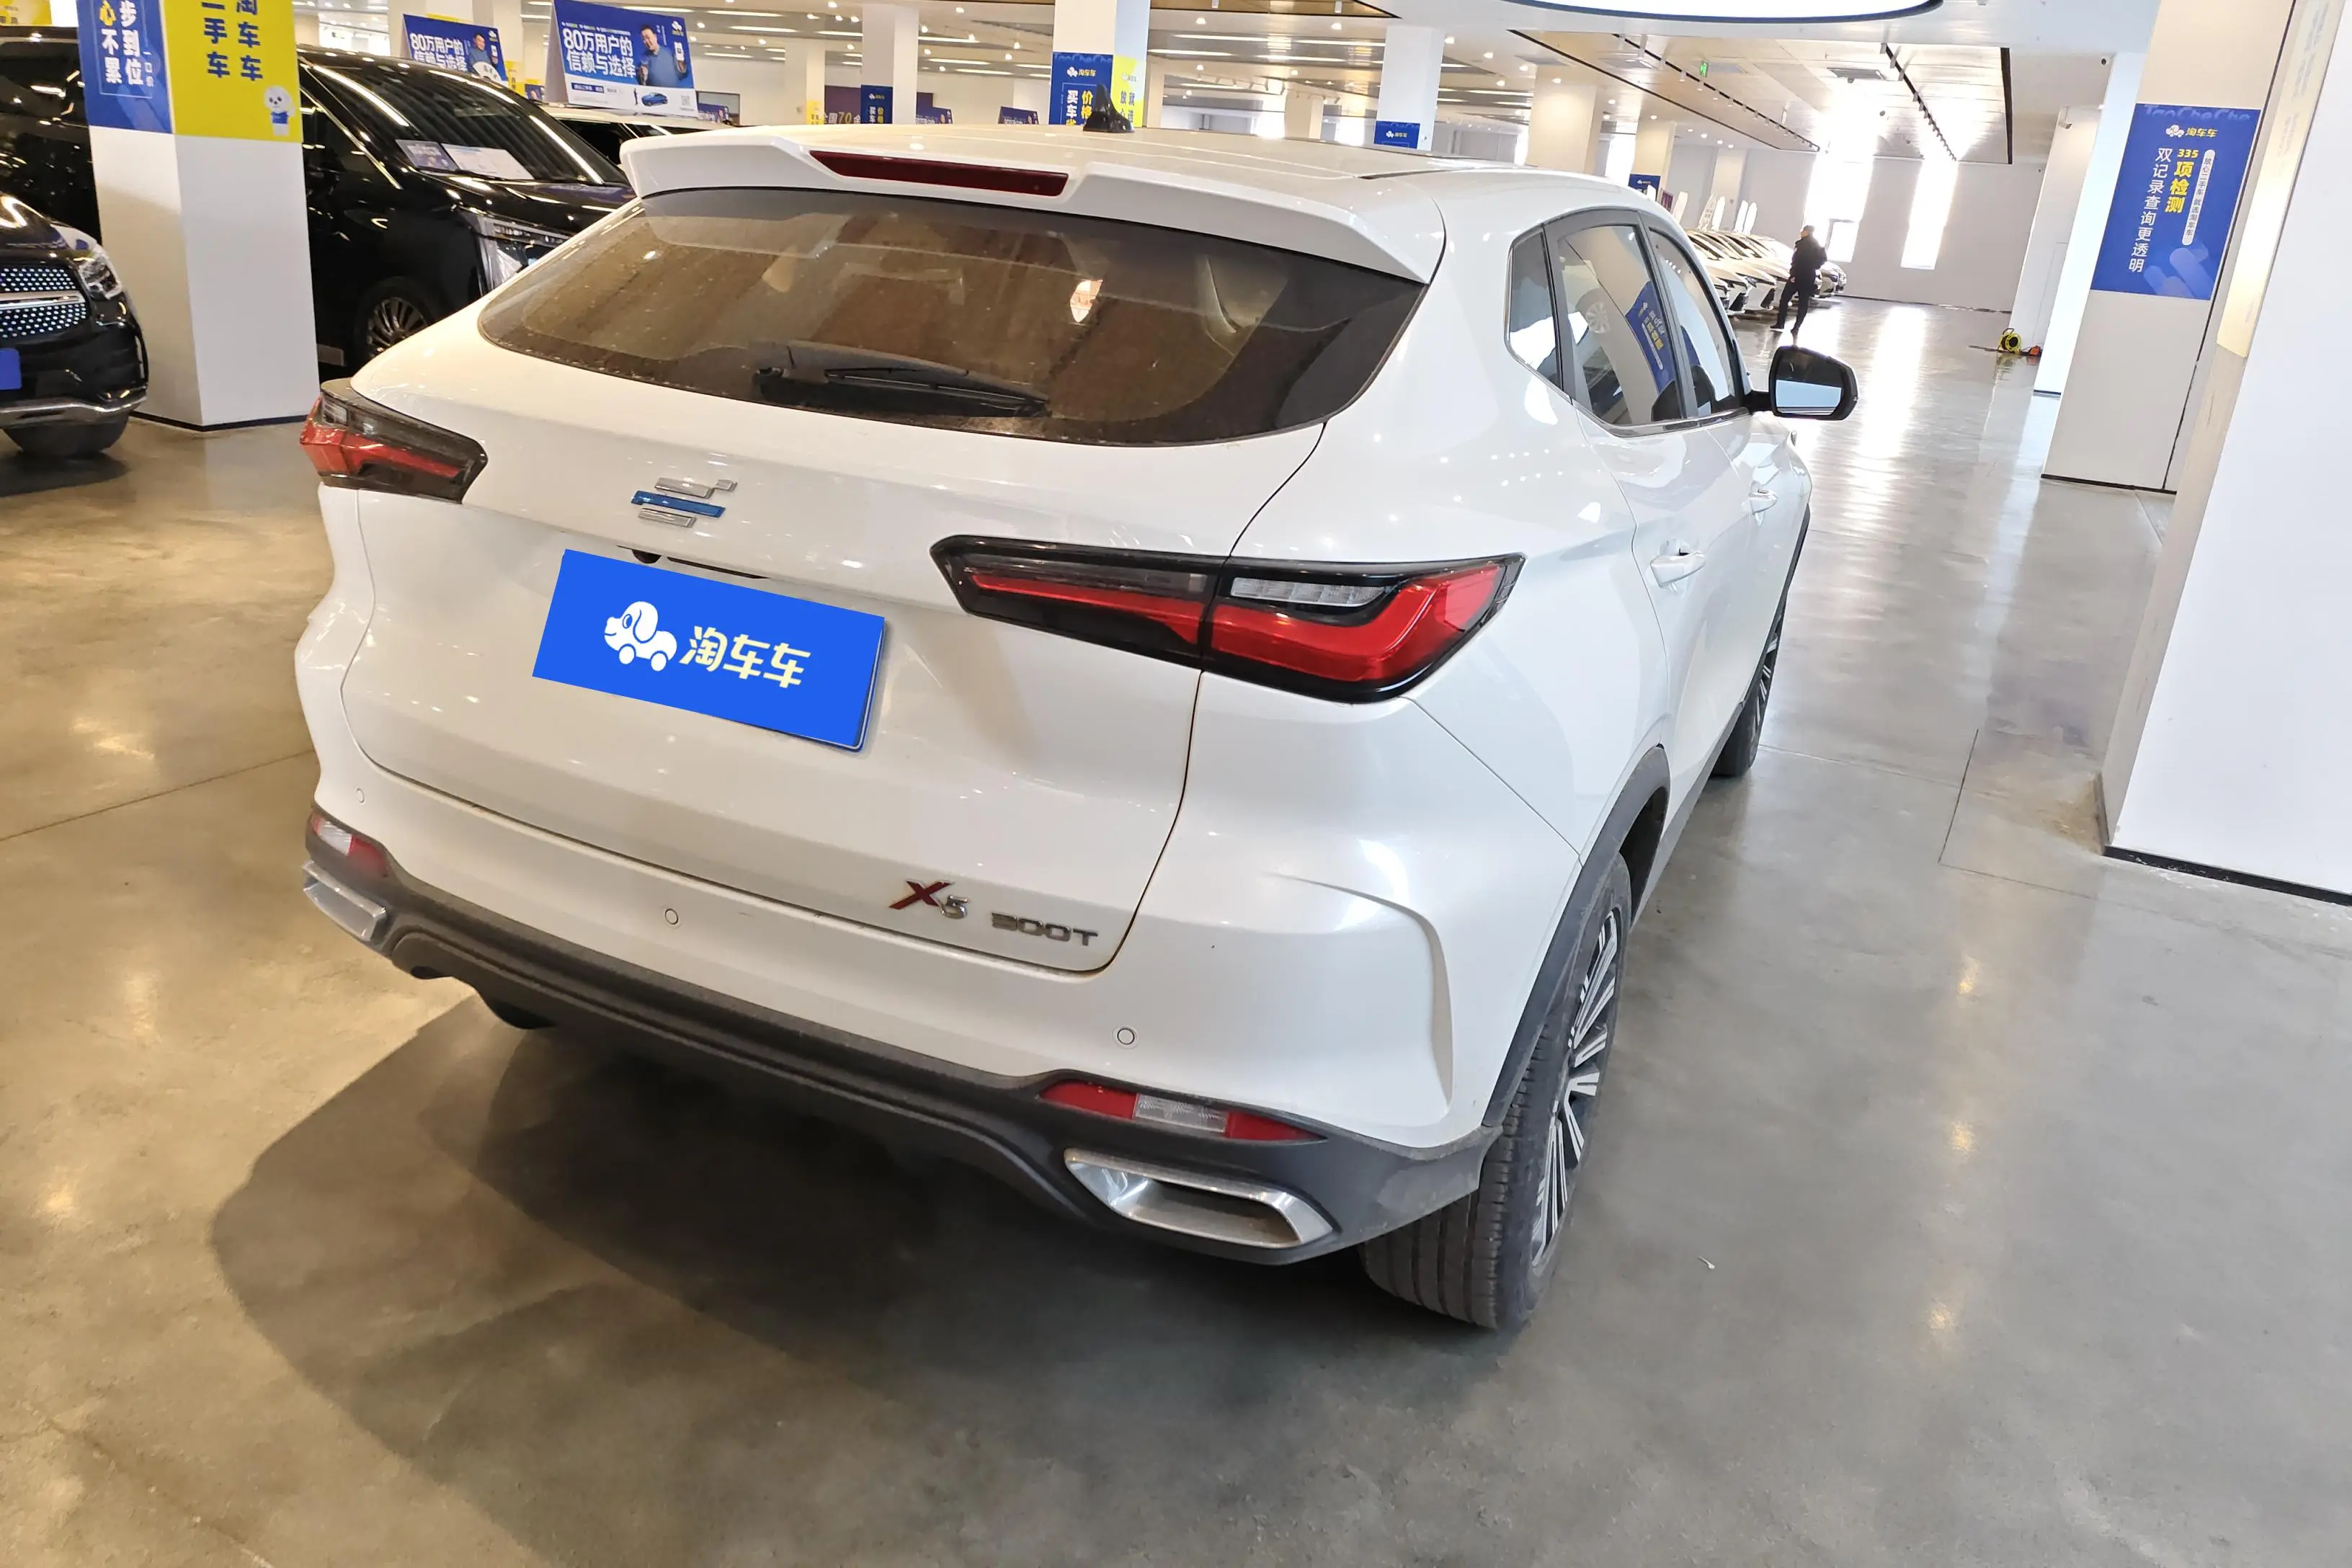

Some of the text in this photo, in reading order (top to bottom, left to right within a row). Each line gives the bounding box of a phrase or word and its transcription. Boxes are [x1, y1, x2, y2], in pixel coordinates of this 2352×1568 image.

[409, 32, 465, 56] 80万用户的
[561, 27, 634, 57] 80万用户的
[566, 48, 637, 79] 信赖与选择
[2184, 127, 2218, 138] 淘车车
[2128, 147, 2173, 273] 双记录查询更透明
[888, 878, 1099, 947] X5 300T
